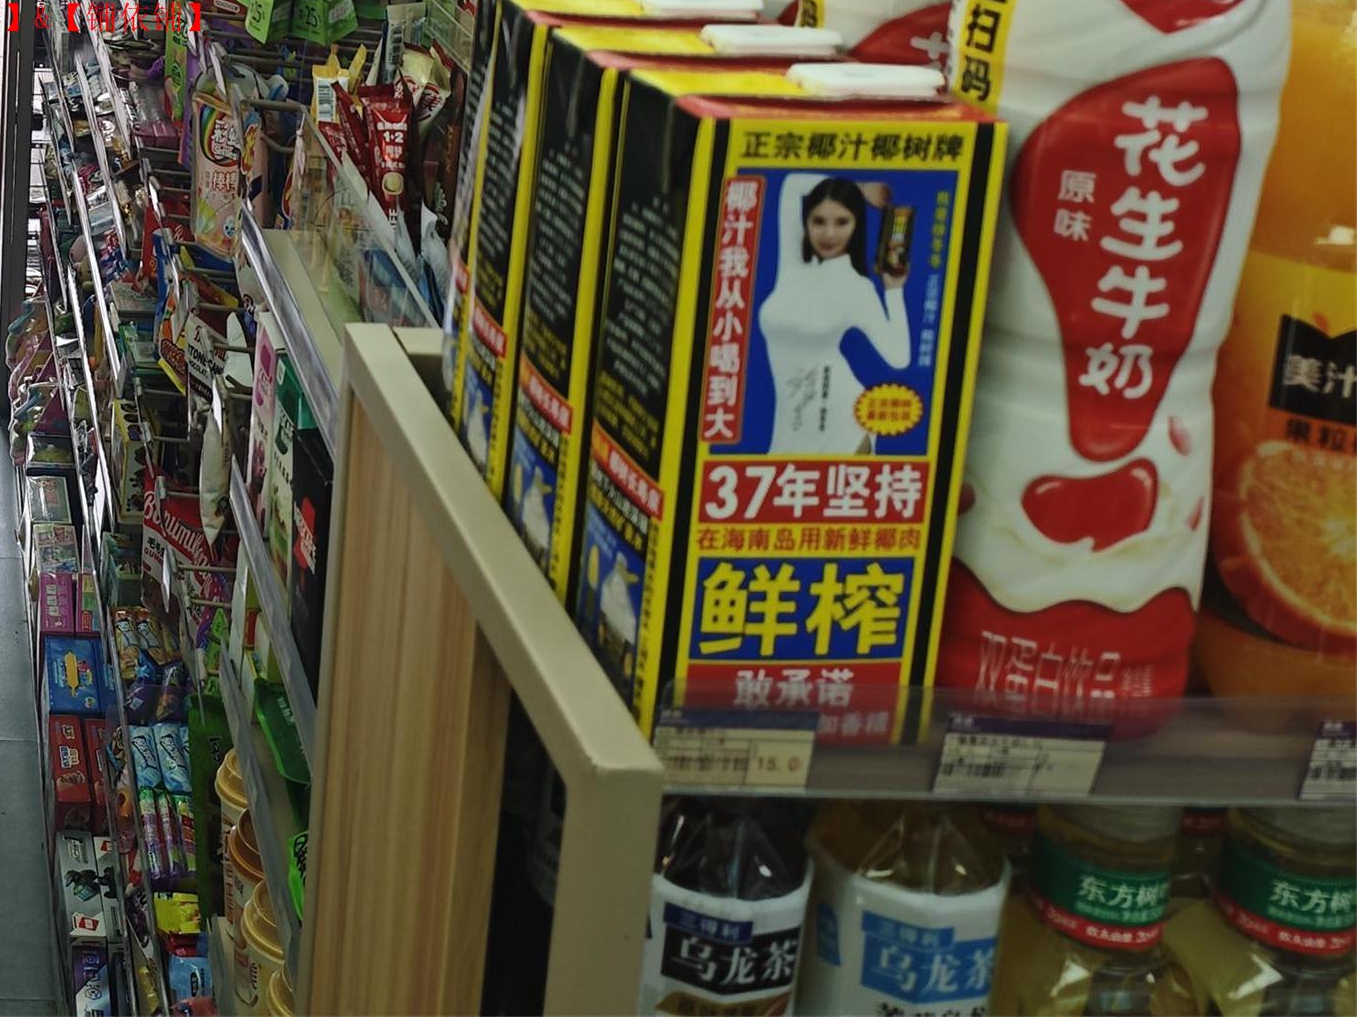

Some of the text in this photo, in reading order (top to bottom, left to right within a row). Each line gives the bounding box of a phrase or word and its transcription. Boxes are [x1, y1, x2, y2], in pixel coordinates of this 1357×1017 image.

[741, 131, 965, 161] 正宗椰汁椰树牌
[1052, 169, 1098, 242] 原味
[1078, 96, 1209, 400] 花生牛奶
[704, 179, 760, 441] 椰汁我从小喝到大
[704, 463, 923, 520] 37年坚持
[695, 527, 922, 552] 在海南岛用新鲜椰肉
[699, 561, 905, 657] 鲜榨
[670, 936, 799, 985] 乌龙茶
